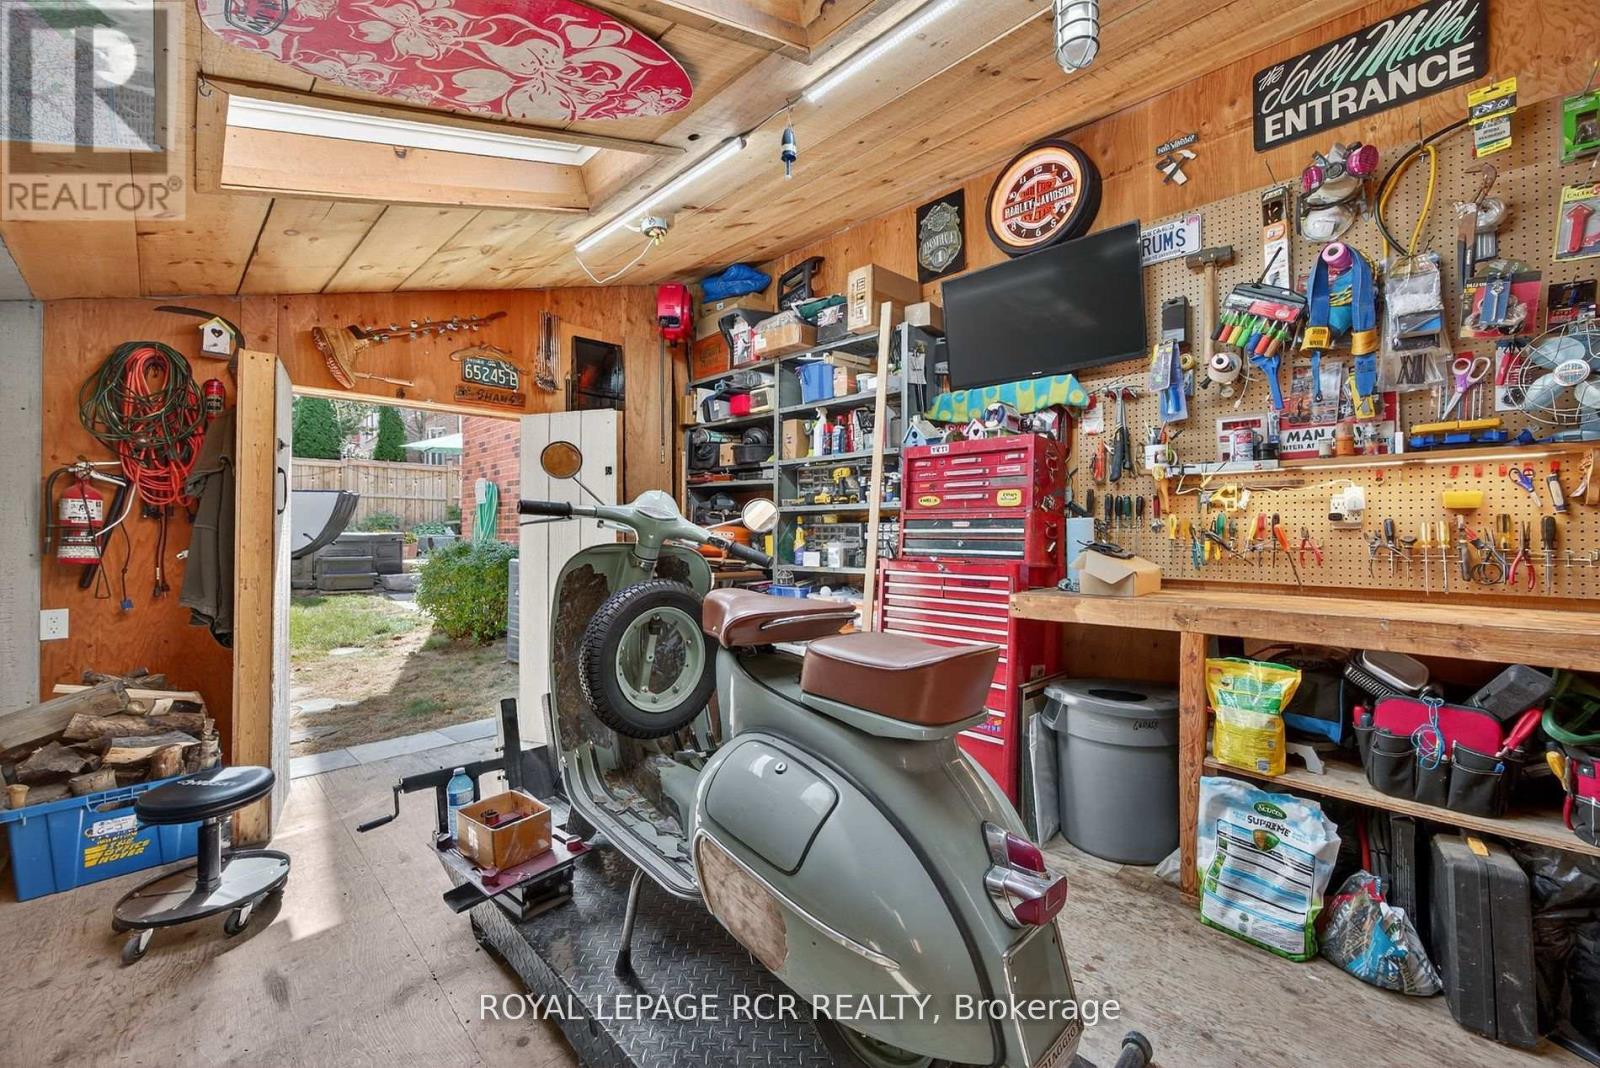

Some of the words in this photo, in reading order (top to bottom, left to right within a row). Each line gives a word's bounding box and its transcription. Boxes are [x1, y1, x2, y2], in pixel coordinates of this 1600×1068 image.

[1264, 42, 1475, 144] ENTRANCE
[1142, 228, 1186, 257] RUMS
[1287, 429, 1325, 443] MAN
[1247, 815, 1291, 837] SUPREME
